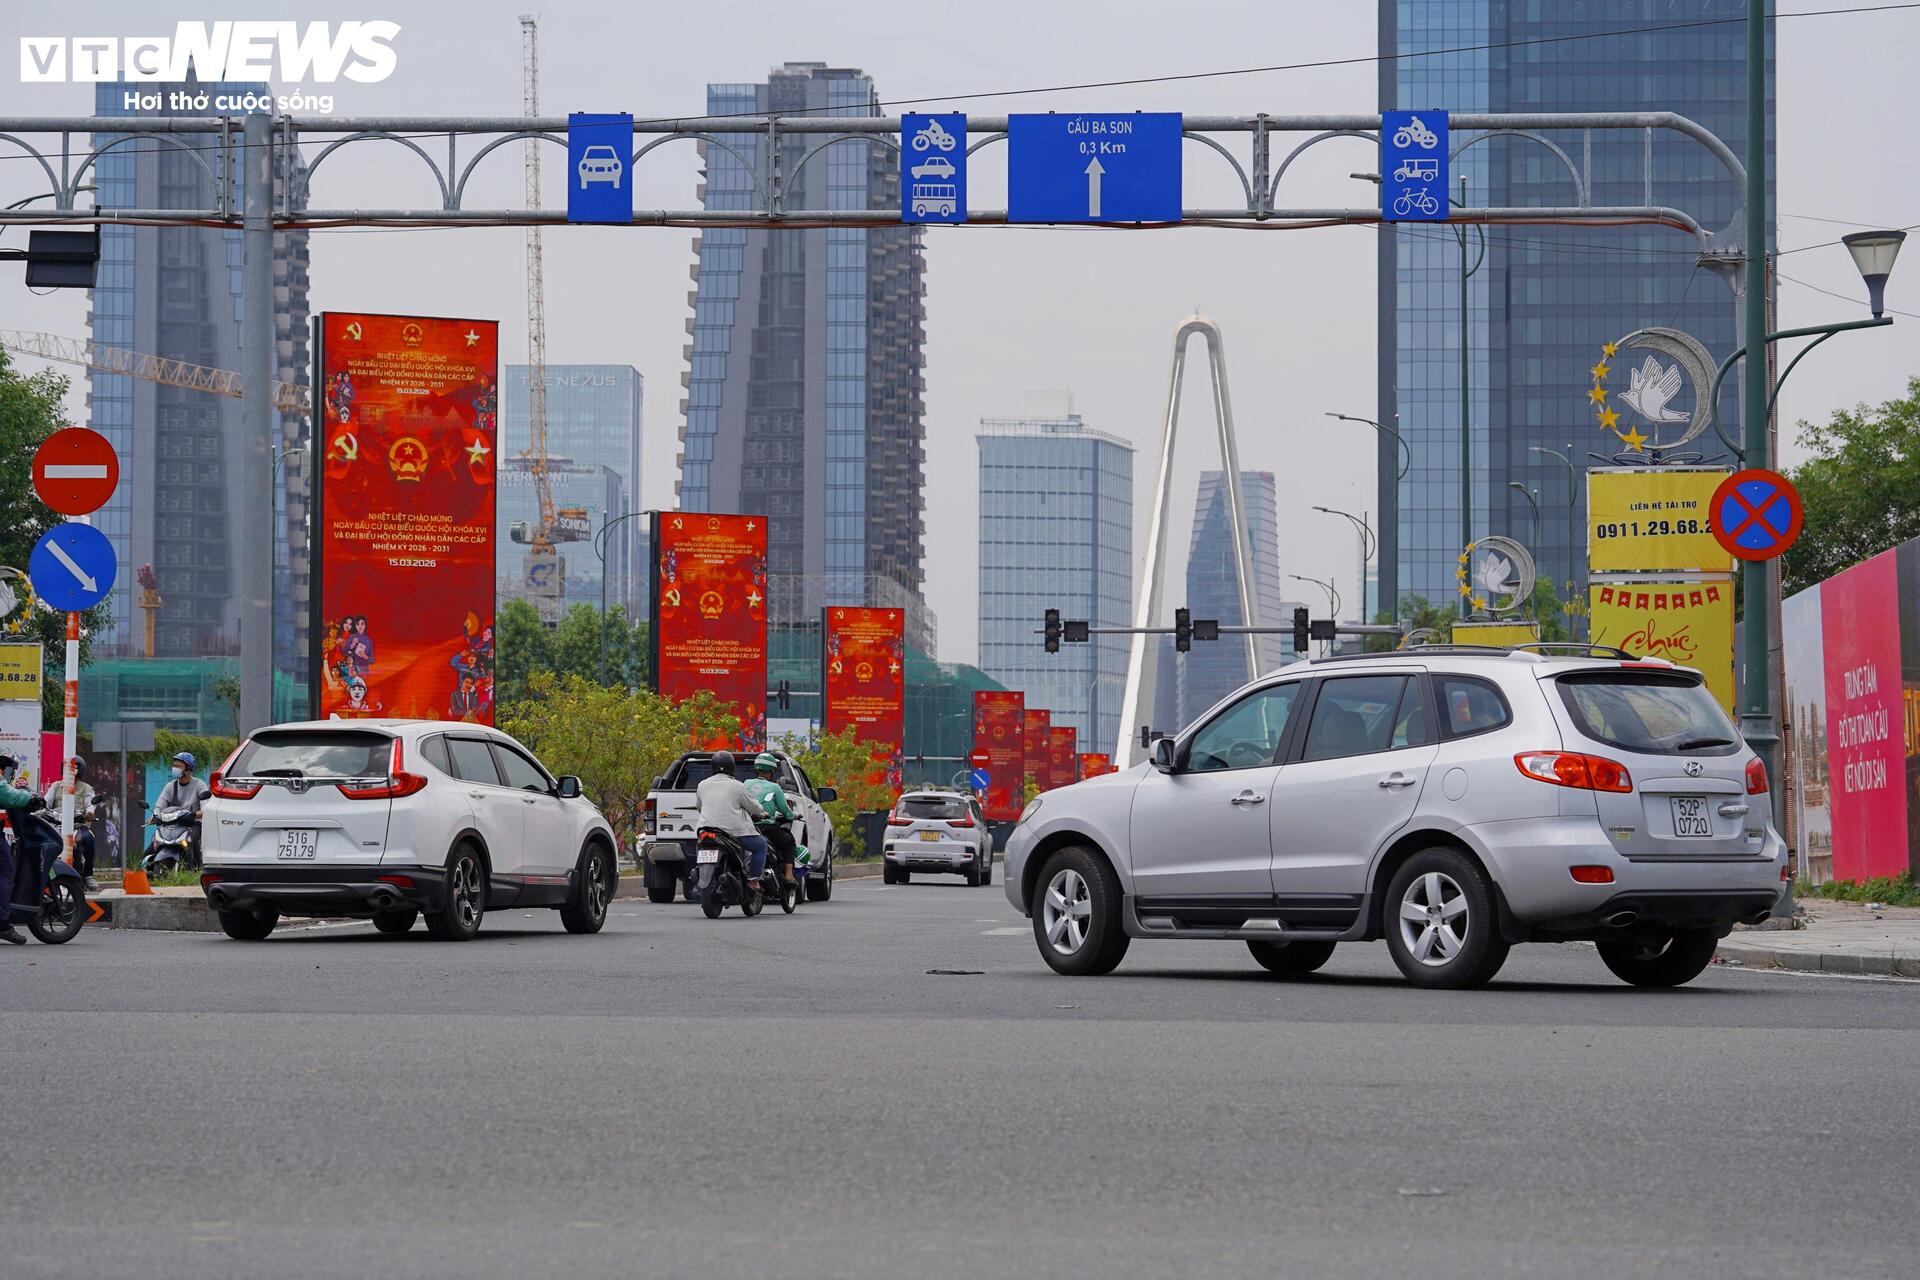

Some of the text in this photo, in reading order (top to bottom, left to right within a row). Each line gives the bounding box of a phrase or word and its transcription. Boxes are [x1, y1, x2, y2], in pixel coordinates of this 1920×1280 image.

[1067, 116, 1132, 134] CẦU BA SON
[1080, 142, 1126, 155] 0,3 Km
[520, 376, 616, 386] TE NEXUS
[1630, 500, 1697, 511] LIÊN HỆ TÀI TRỢ
[1619, 618, 1698, 660] Chúc
[1844, 658, 1877, 700] TRUNG TÂM
[1839, 700, 1888, 750] ĐÔ THỊ TOÀN CẦU
[1844, 750, 1887, 793] KẾT NỐI DI SẢN
[1679, 800, 1700, 816] 52P
[1678, 817, 1708, 834] 0720
[288, 832, 307, 844] 51G
[280, 845, 314, 858] 751.79
